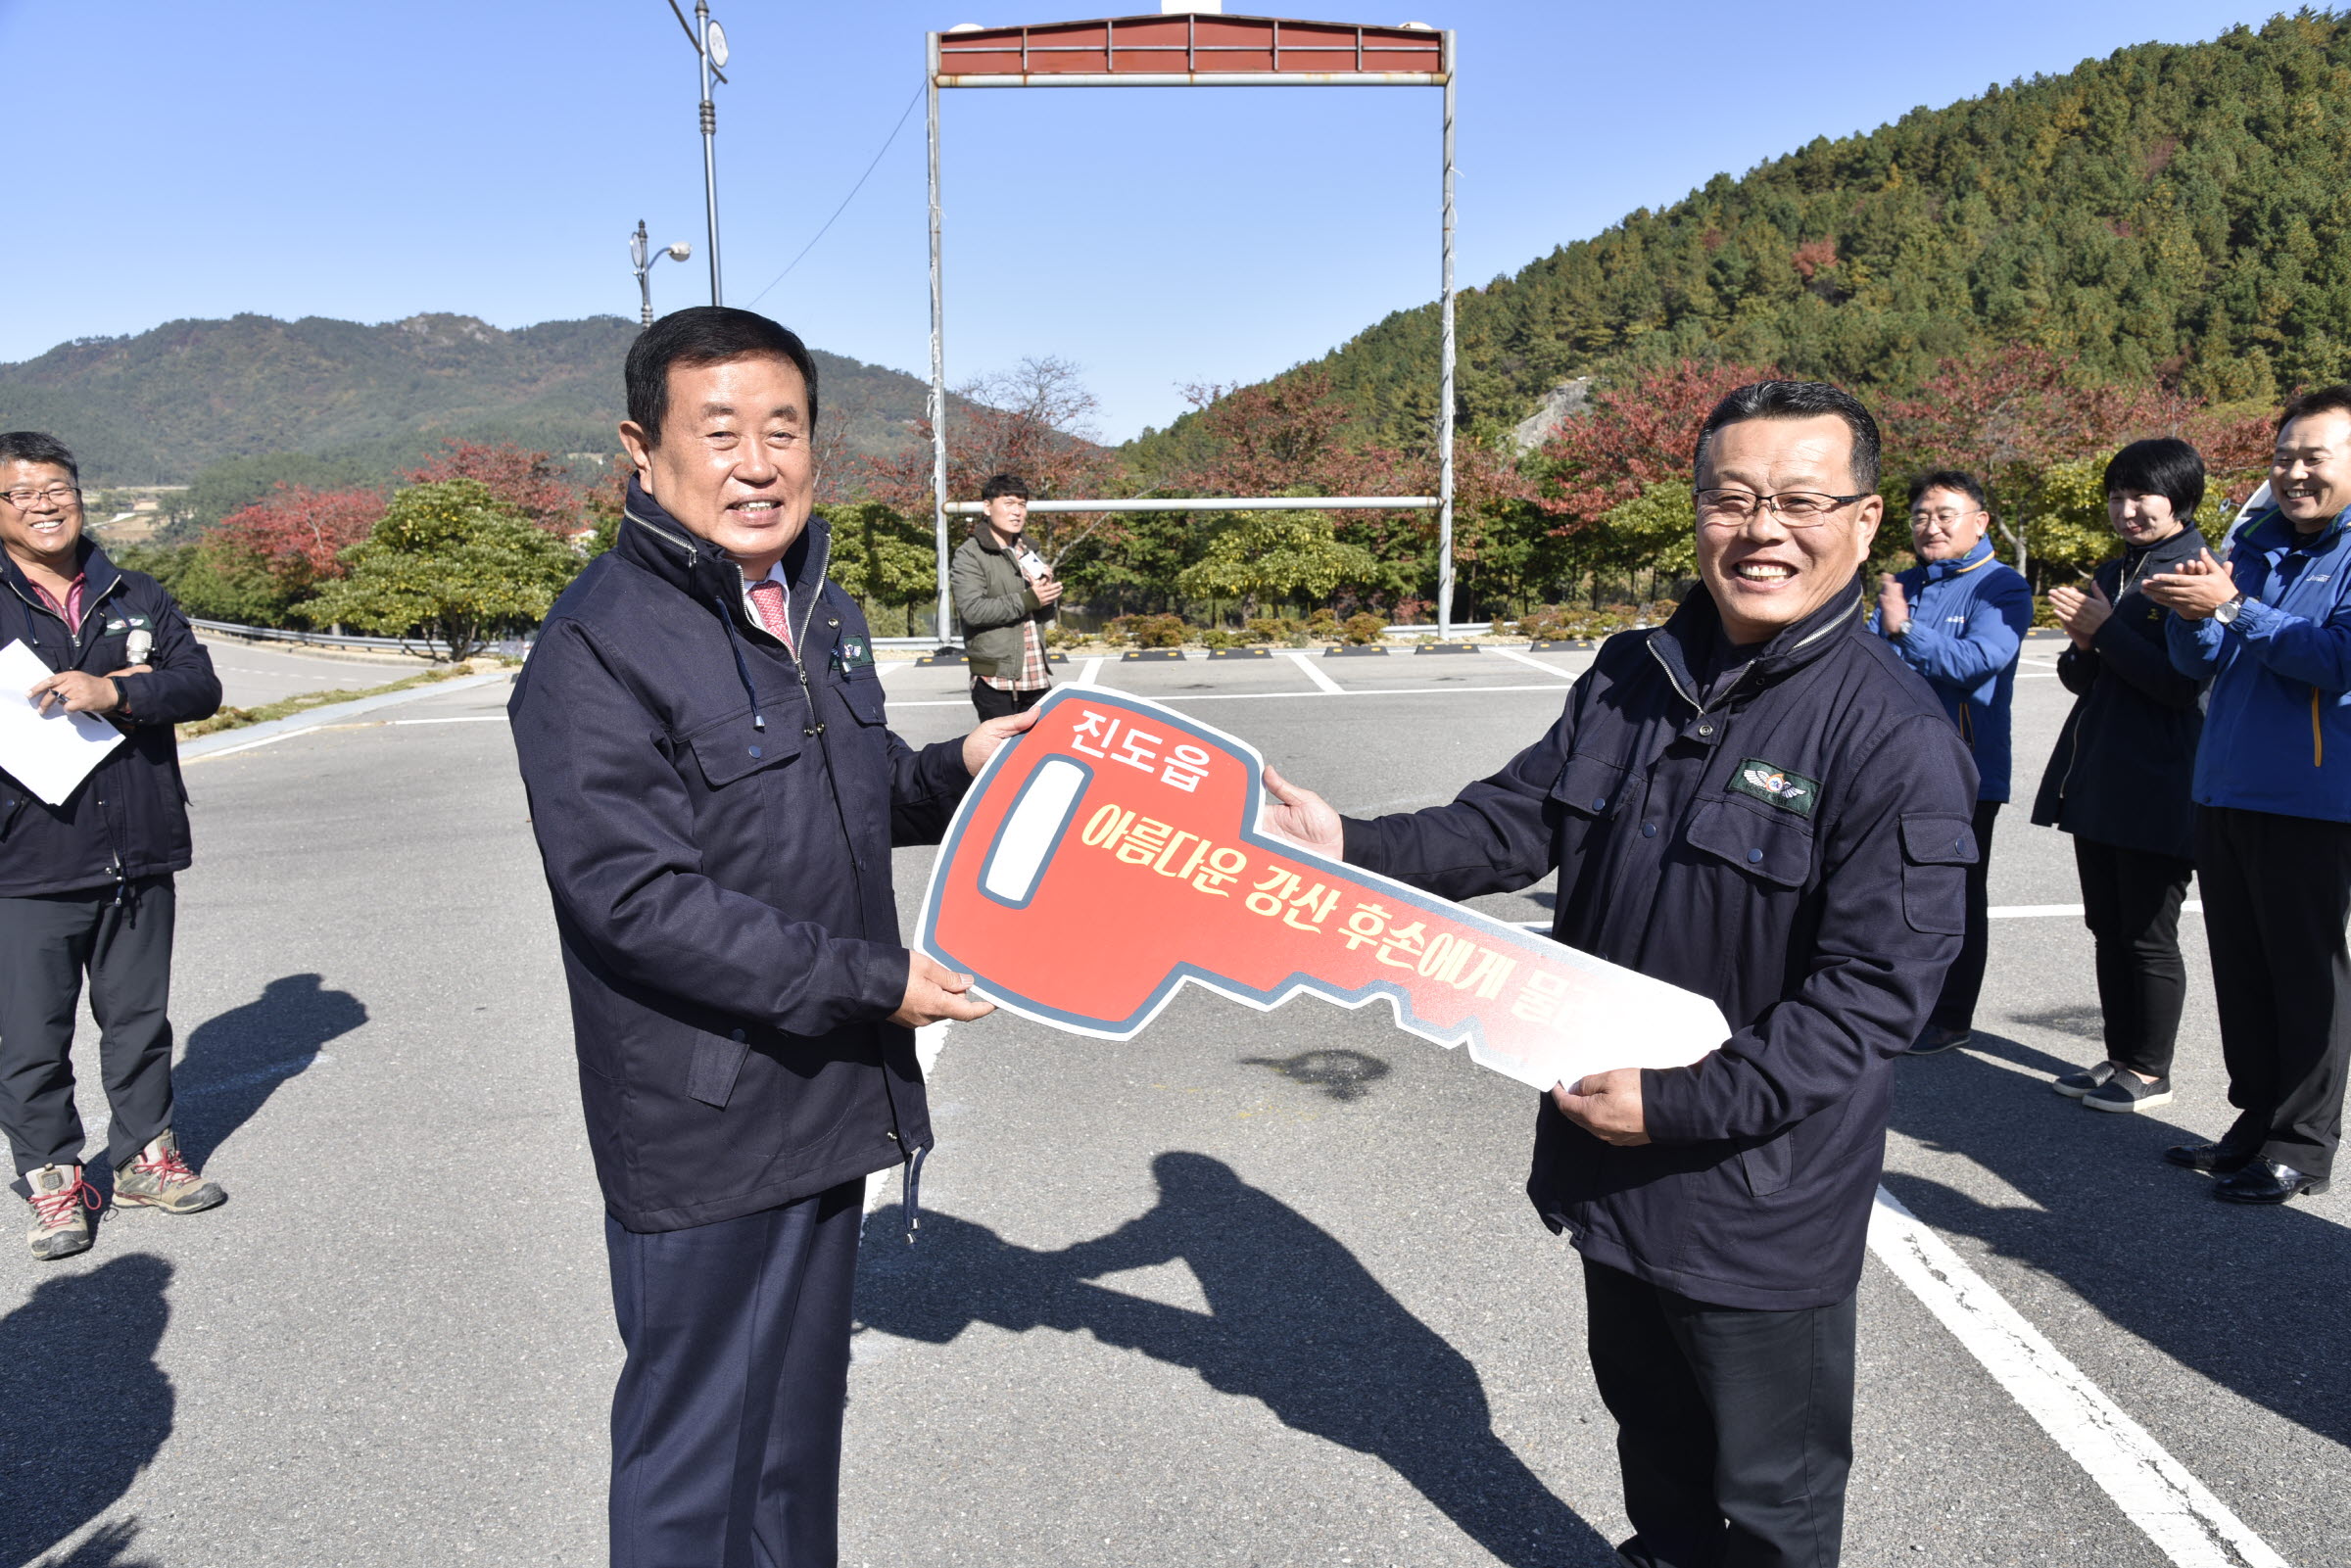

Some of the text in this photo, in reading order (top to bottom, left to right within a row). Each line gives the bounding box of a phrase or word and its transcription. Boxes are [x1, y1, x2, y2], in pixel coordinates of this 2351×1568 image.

[1071, 709, 1210, 793] 진도읍
[1081, 803, 1248, 898] 아름다운
[1245, 865, 1343, 935] 강산
[1337, 902, 1517, 1001] 후손에게
